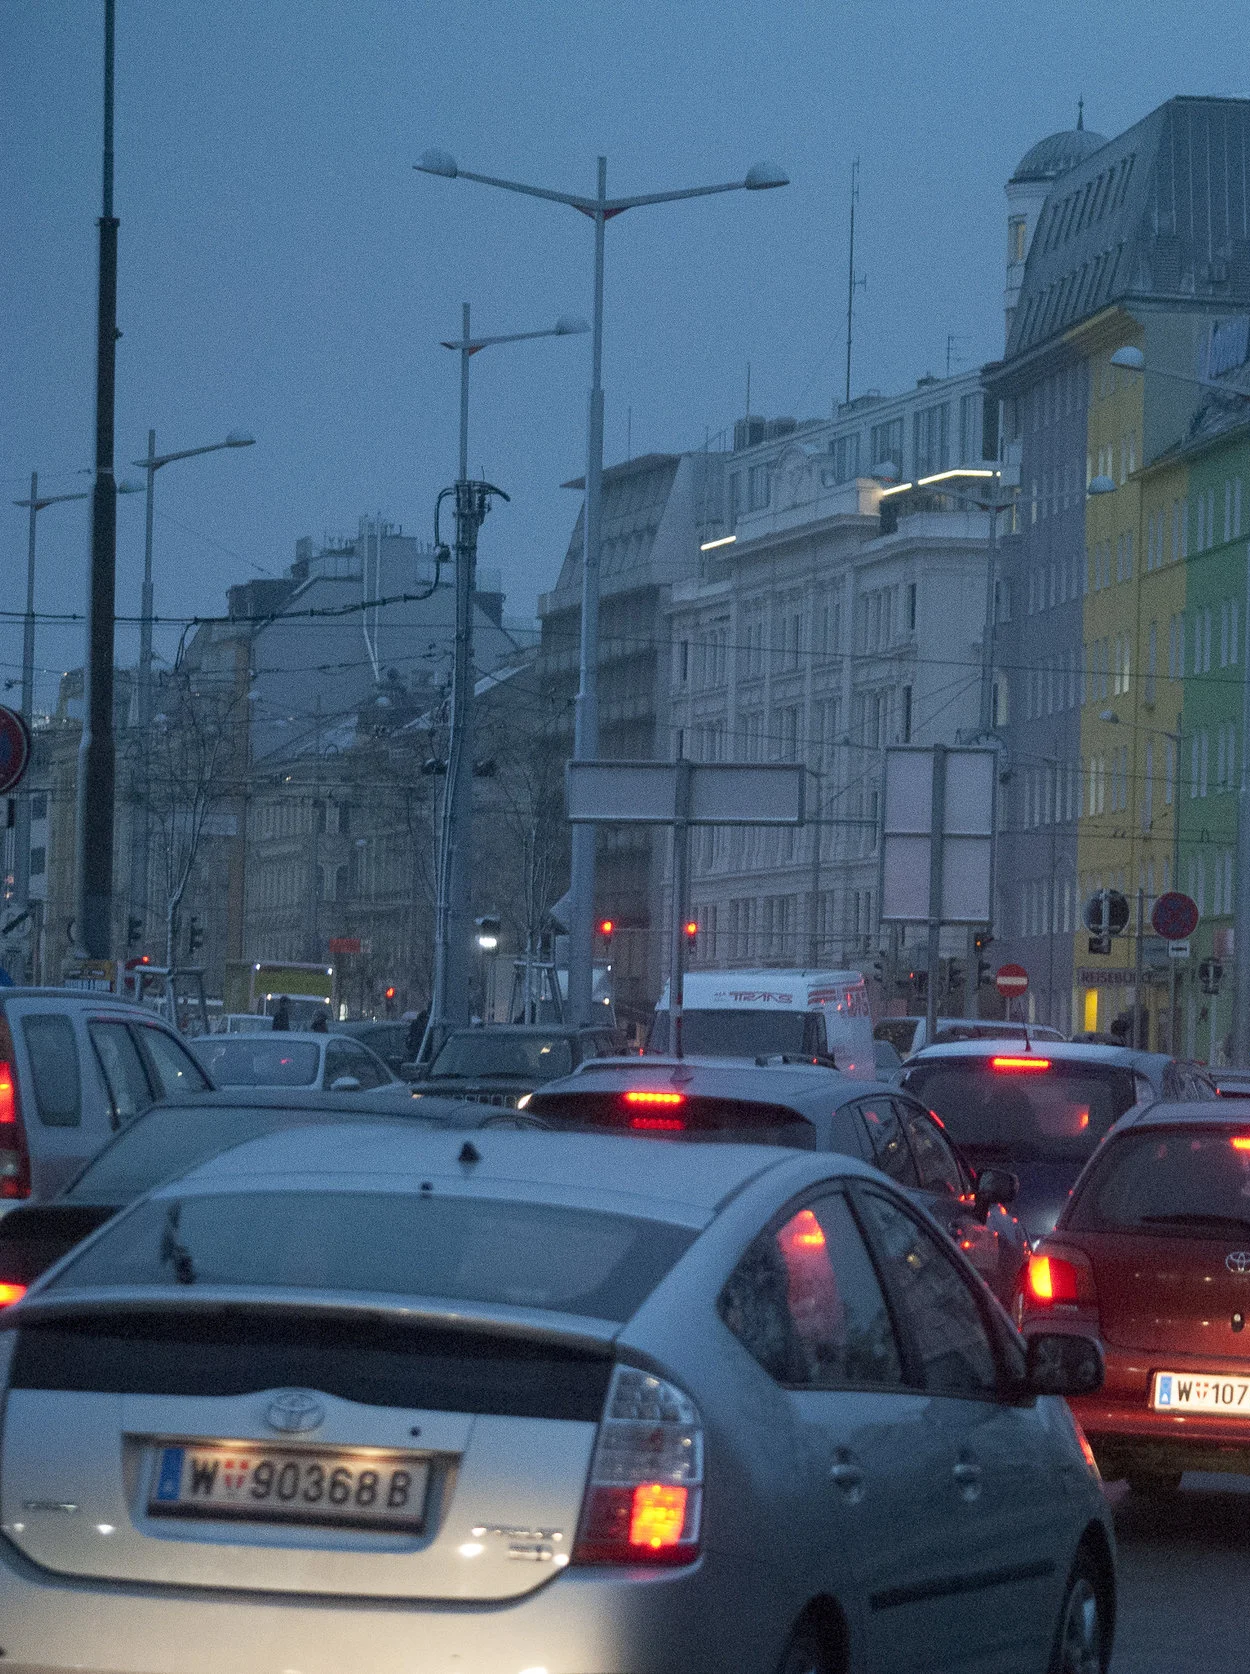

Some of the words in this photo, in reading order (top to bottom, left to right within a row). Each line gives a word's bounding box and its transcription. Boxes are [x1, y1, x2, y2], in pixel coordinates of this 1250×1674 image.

[729, 990, 793, 1005] TRANS
[1177, 1380, 1193, 1402] W
[190, 1457, 219, 1496] W
[251, 1458, 380, 1507] 90368
[387, 1467, 413, 1509] B
